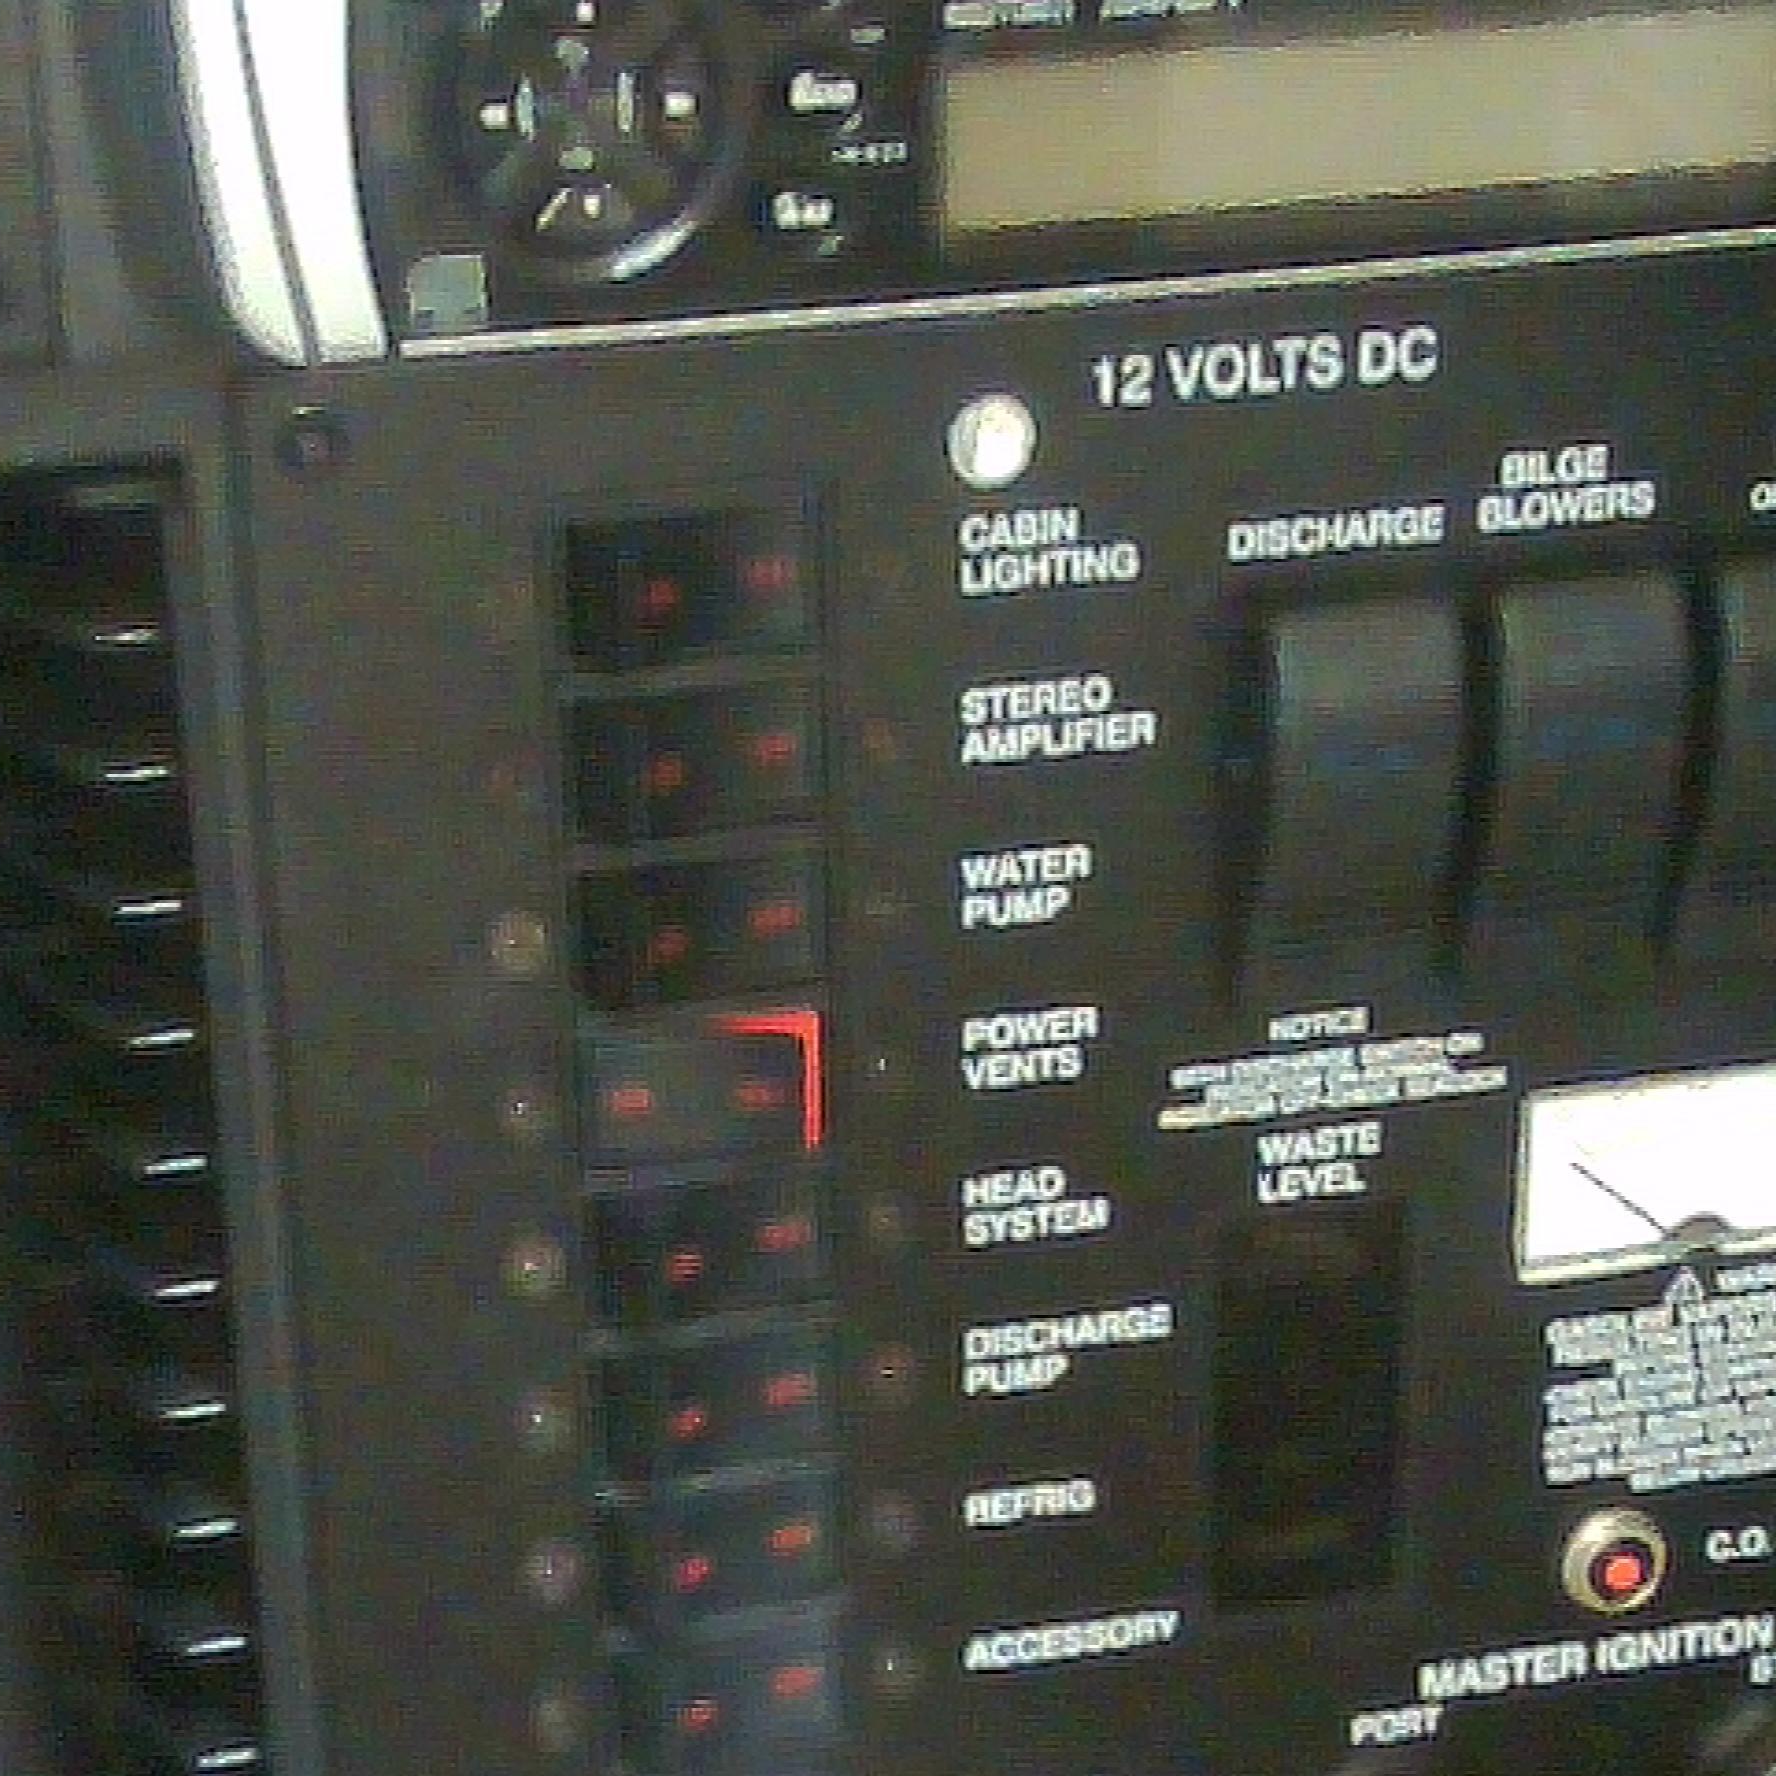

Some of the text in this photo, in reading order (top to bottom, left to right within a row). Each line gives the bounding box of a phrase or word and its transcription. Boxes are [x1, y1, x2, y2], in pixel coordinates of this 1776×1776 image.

[1092, 324, 1438, 407] 12 VOLTS DC
[1501, 444, 1610, 487] BILGE
[959, 507, 1081, 553] CABIN
[1476, 479, 1657, 534] BLOWERS
[1228, 504, 1446, 563] DISCHARGE
[960, 542, 1142, 597] LIGHTING
[961, 673, 1114, 725] STEREO
[961, 711, 1158, 764] AMPLIFIER
[960, 843, 1093, 889] WATER
[962, 886, 1072, 930] PUMP
[962, 1006, 1100, 1052] POWER
[962, 1045, 1084, 1091] VENTS
[1257, 1121, 1383, 1167] WASTE
[962, 1166, 1067, 1208] HEAD
[1257, 1162, 1367, 1204] LEVEL
[963, 1196, 1112, 1248] SYSTEM
[963, 1304, 1174, 1362] DISCHARGE
[964, 1355, 1070, 1397] PUMP
[964, 1479, 1097, 1528] REFRIG
[963, 1610, 1181, 1671] ACCESSORY
[1418, 1613, 1776, 1699] MASTER IGNITION
[1349, 1703, 1444, 1747] PORT
